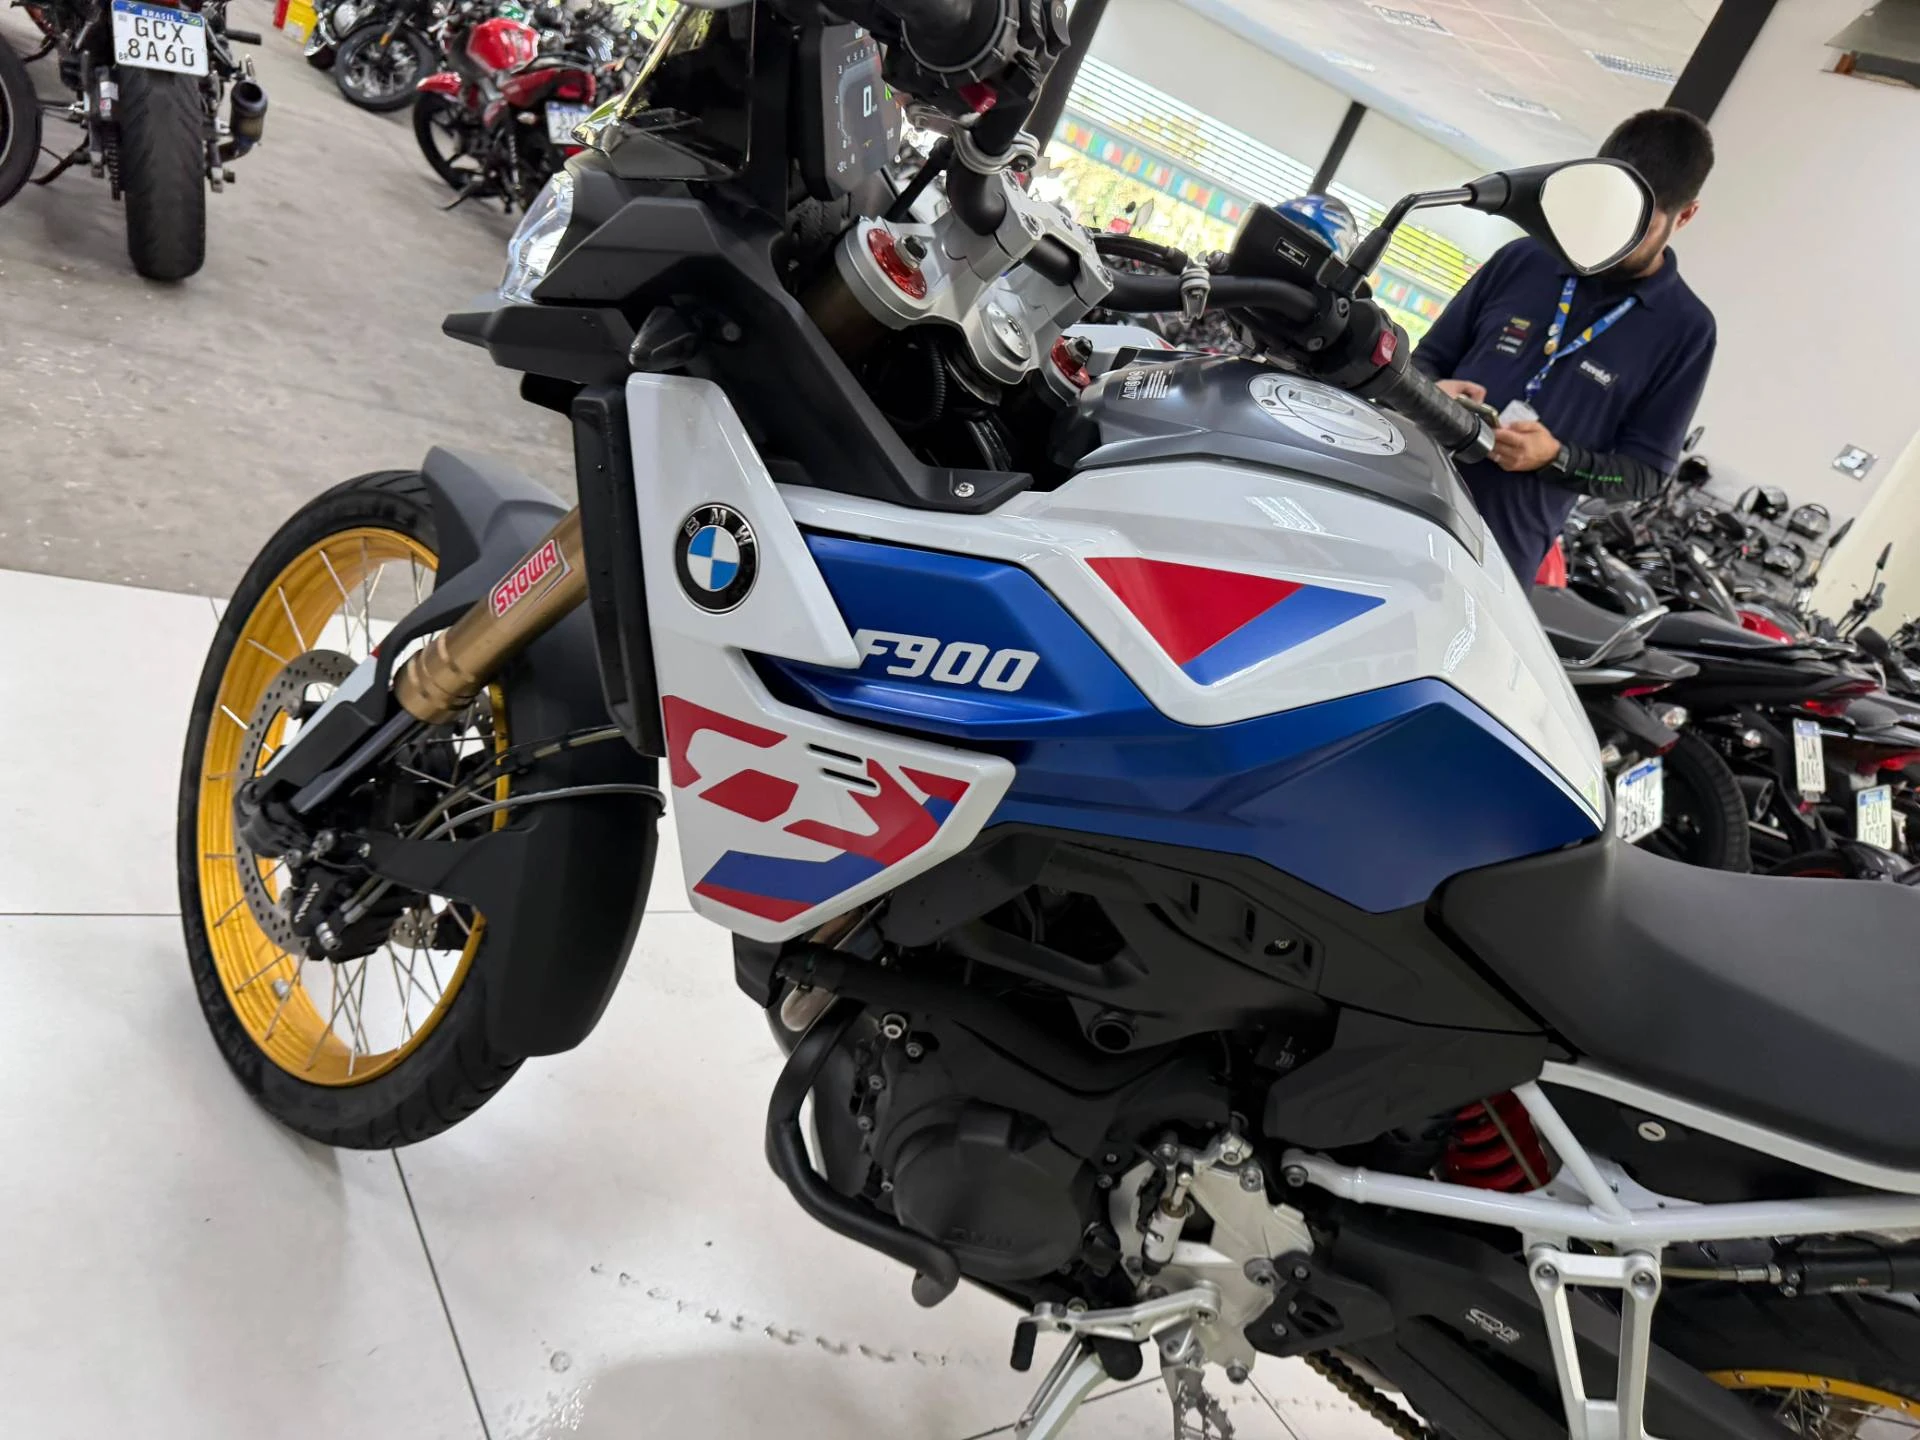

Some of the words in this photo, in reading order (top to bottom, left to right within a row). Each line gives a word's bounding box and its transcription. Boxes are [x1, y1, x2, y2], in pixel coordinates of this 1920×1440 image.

[134, 16, 185, 45] GCX
[141, 9, 175, 20] BRASIL
[127, 37, 196, 67] 8A60
[863, 85, 872, 117] 0
[684, 507, 754, 547] BMW
[494, 540, 558, 617] SHOWA
[852, 628, 1041, 693] F900
